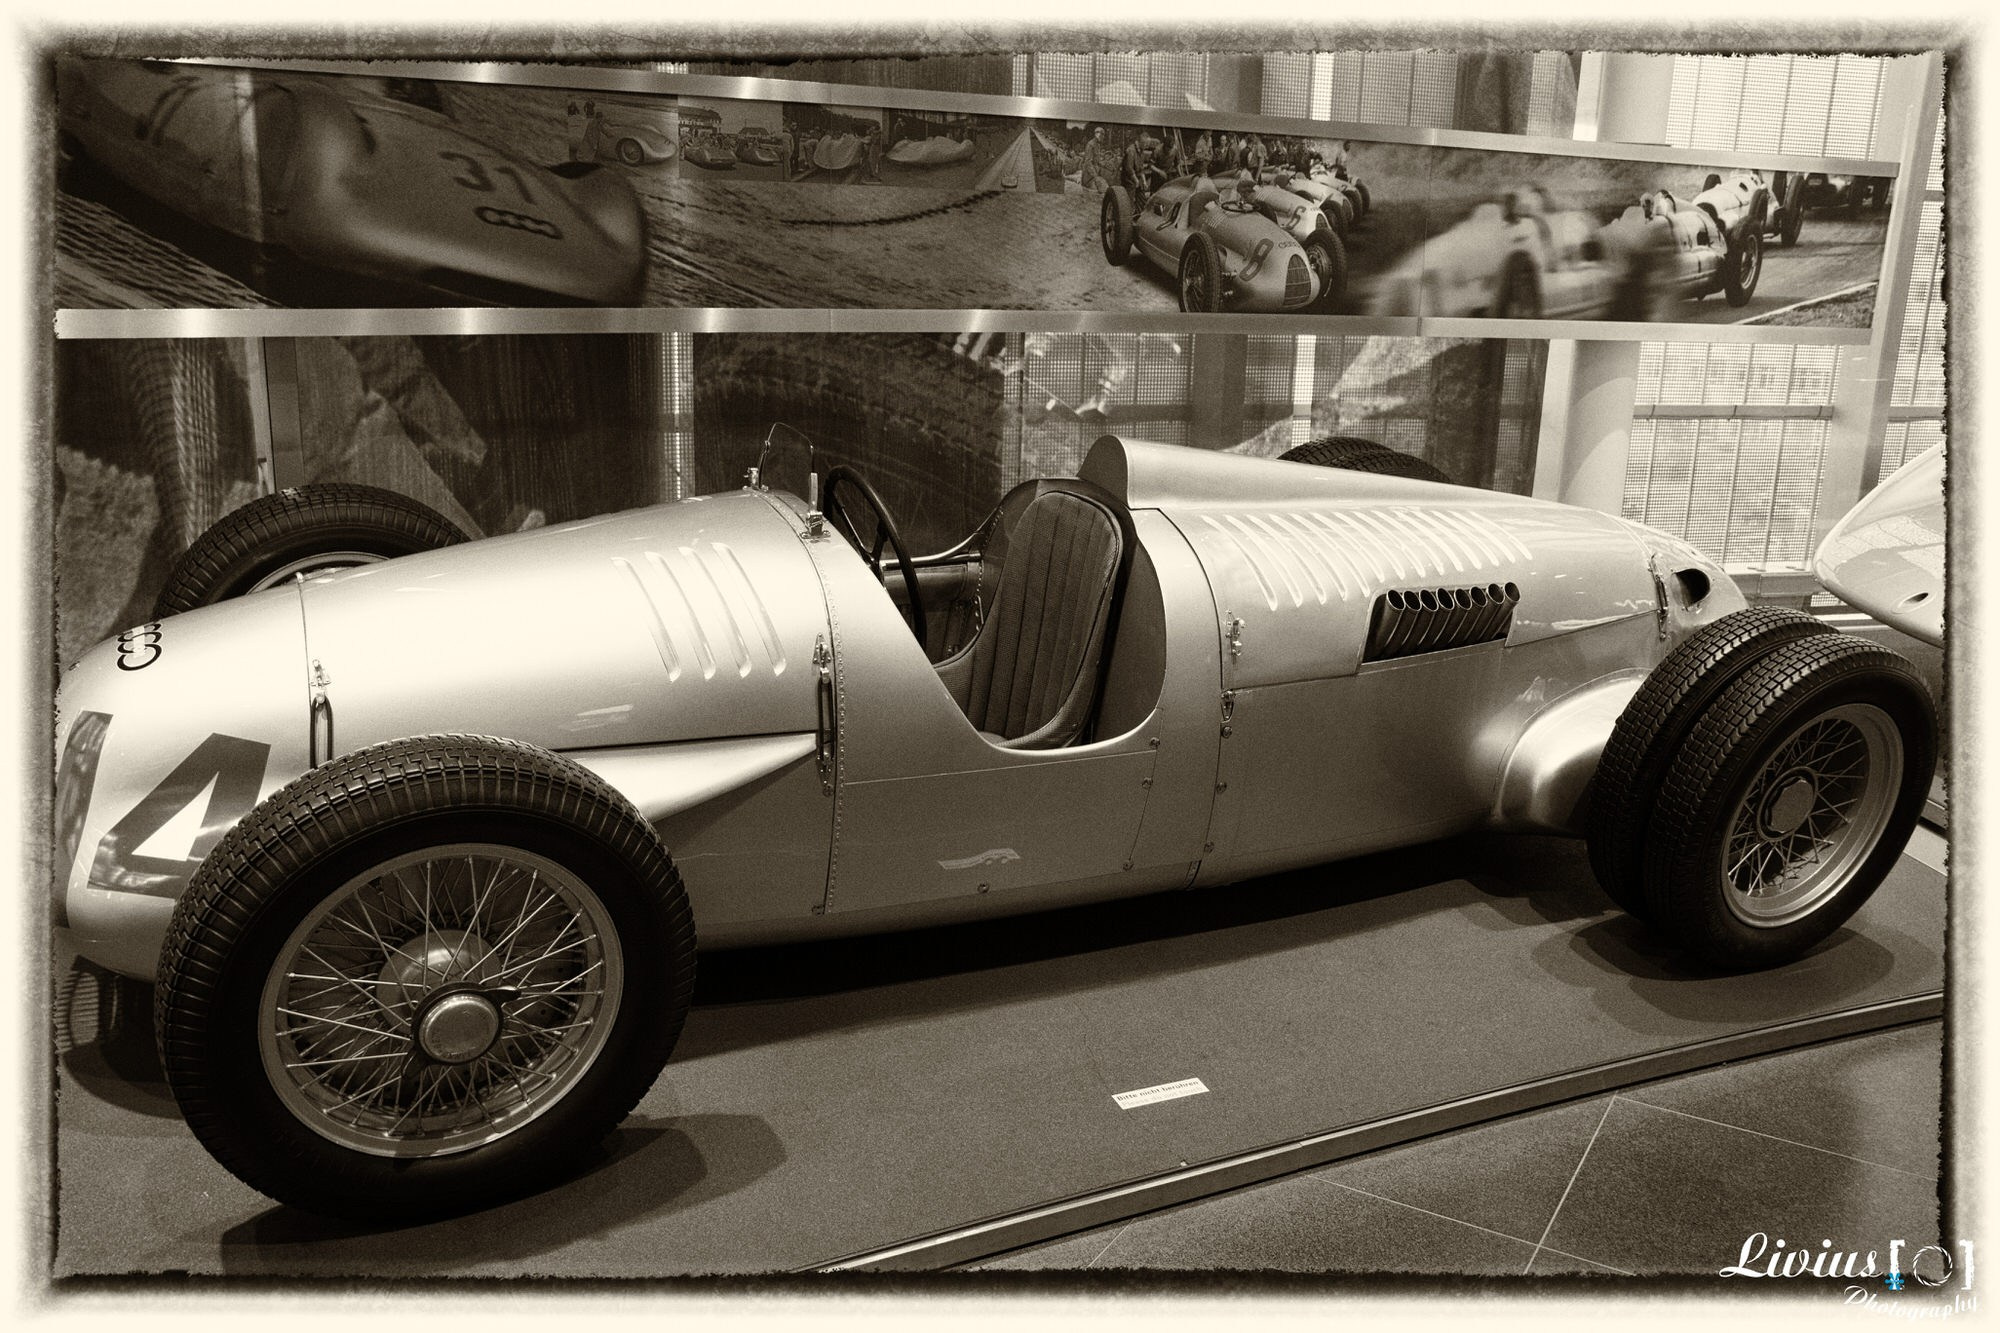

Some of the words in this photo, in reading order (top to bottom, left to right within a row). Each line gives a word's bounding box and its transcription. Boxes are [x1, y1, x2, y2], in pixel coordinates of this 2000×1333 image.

[1239, 238, 1274, 281] 8
[1116, 1093, 1138, 1102] Bitte
[1139, 1088, 1161, 1097] nicht
